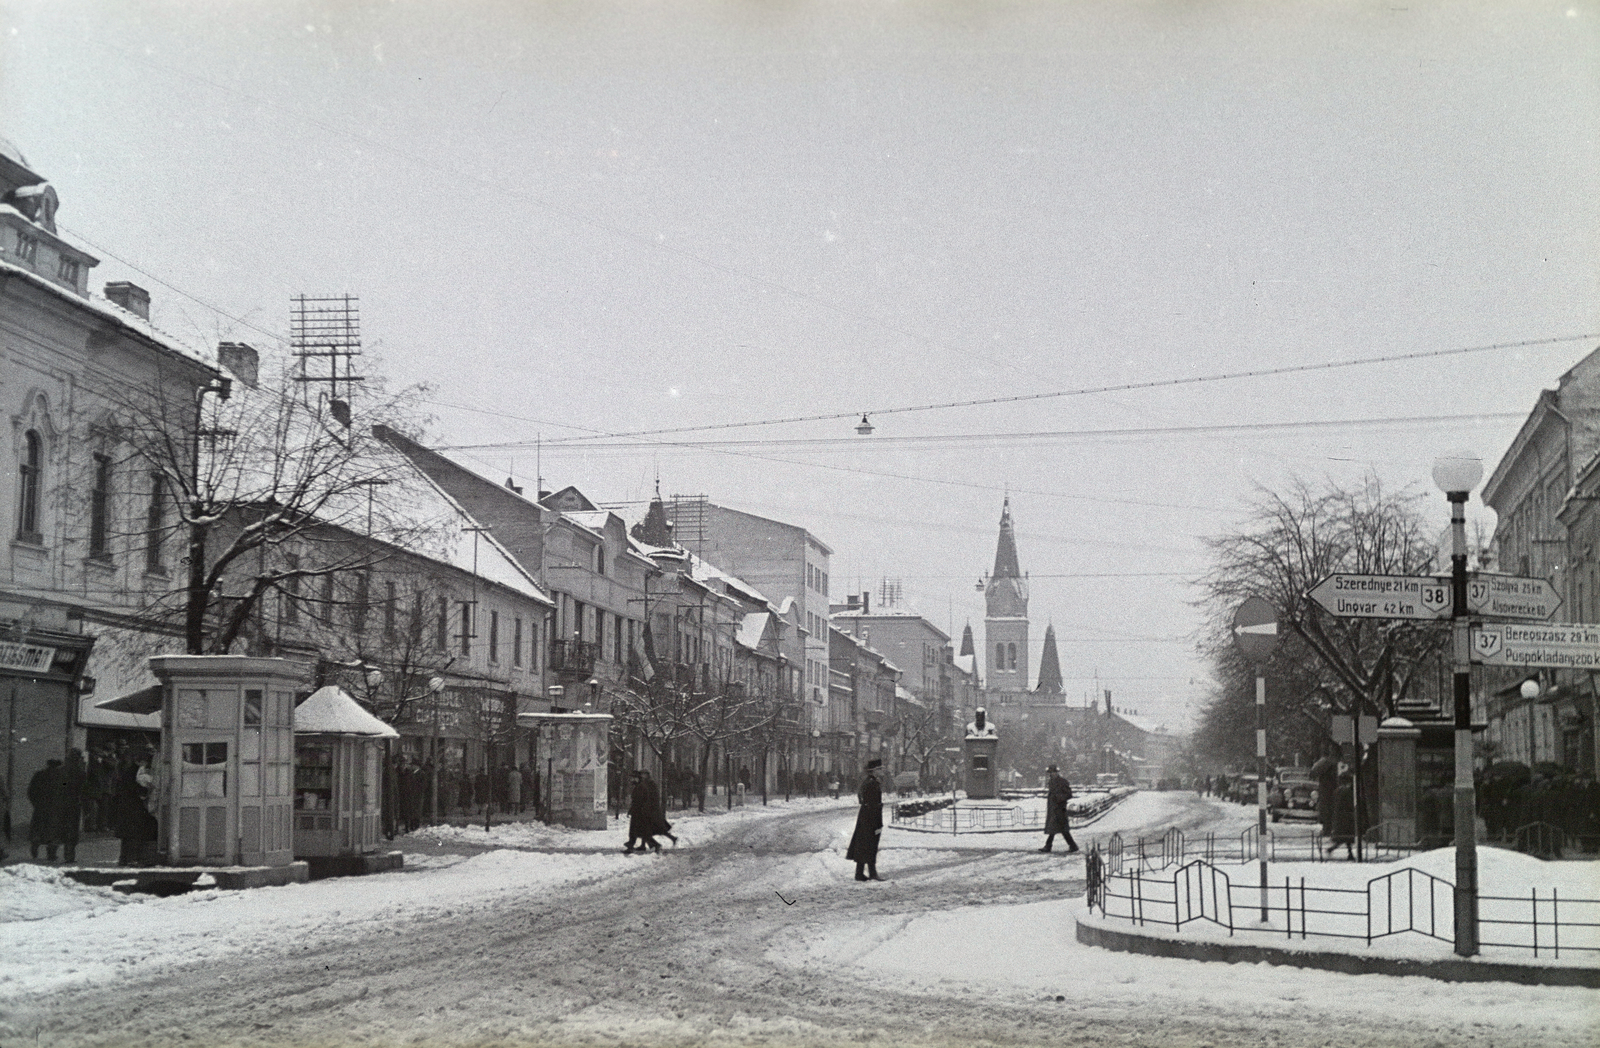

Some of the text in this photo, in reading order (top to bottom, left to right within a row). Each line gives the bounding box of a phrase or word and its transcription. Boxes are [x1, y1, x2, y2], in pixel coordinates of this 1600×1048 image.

[1335, 576, 1419, 593] Szerednye 21 km
[1471, 584, 1486, 598] 37
[1532, 580, 1542, 594] km
[1424, 588, 1444, 604] 38
[1383, 602, 1396, 614] 42
[1399, 601, 1414, 615] km
[1480, 634, 1498, 649] 37
[1583, 630, 1599, 643] km
[1575, 654, 1593, 665] 200
